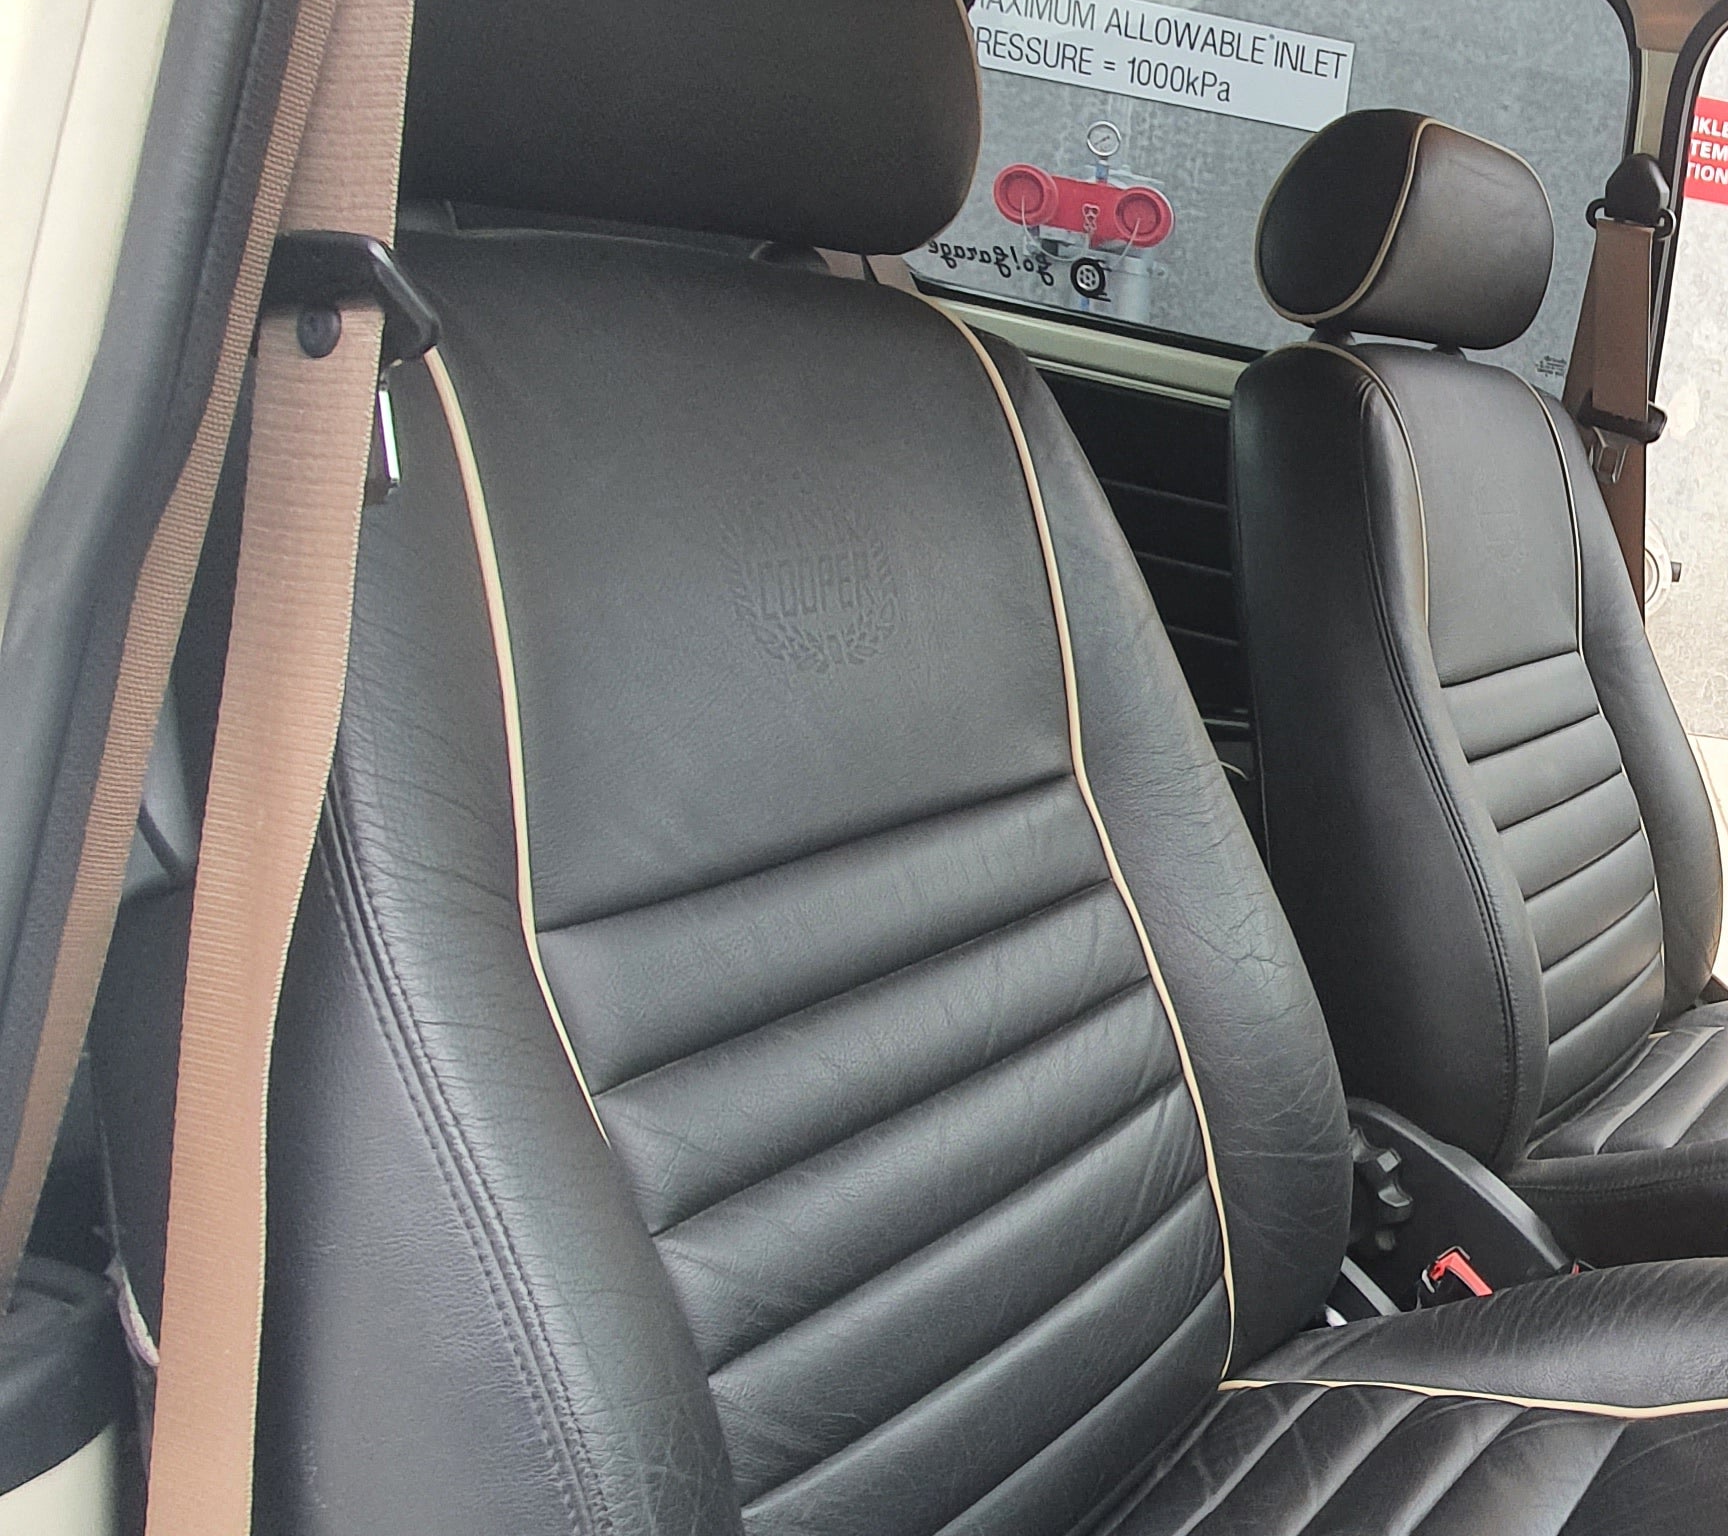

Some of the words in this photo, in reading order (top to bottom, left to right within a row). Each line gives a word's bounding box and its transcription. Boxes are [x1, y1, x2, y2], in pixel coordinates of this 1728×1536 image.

[1103, 7, 1267, 64] ALLOWABLE
[1273, 40, 1348, 80] INLET
[1103, 59, 1117, 72] =
[1127, 56, 1231, 103] 1000kPa
